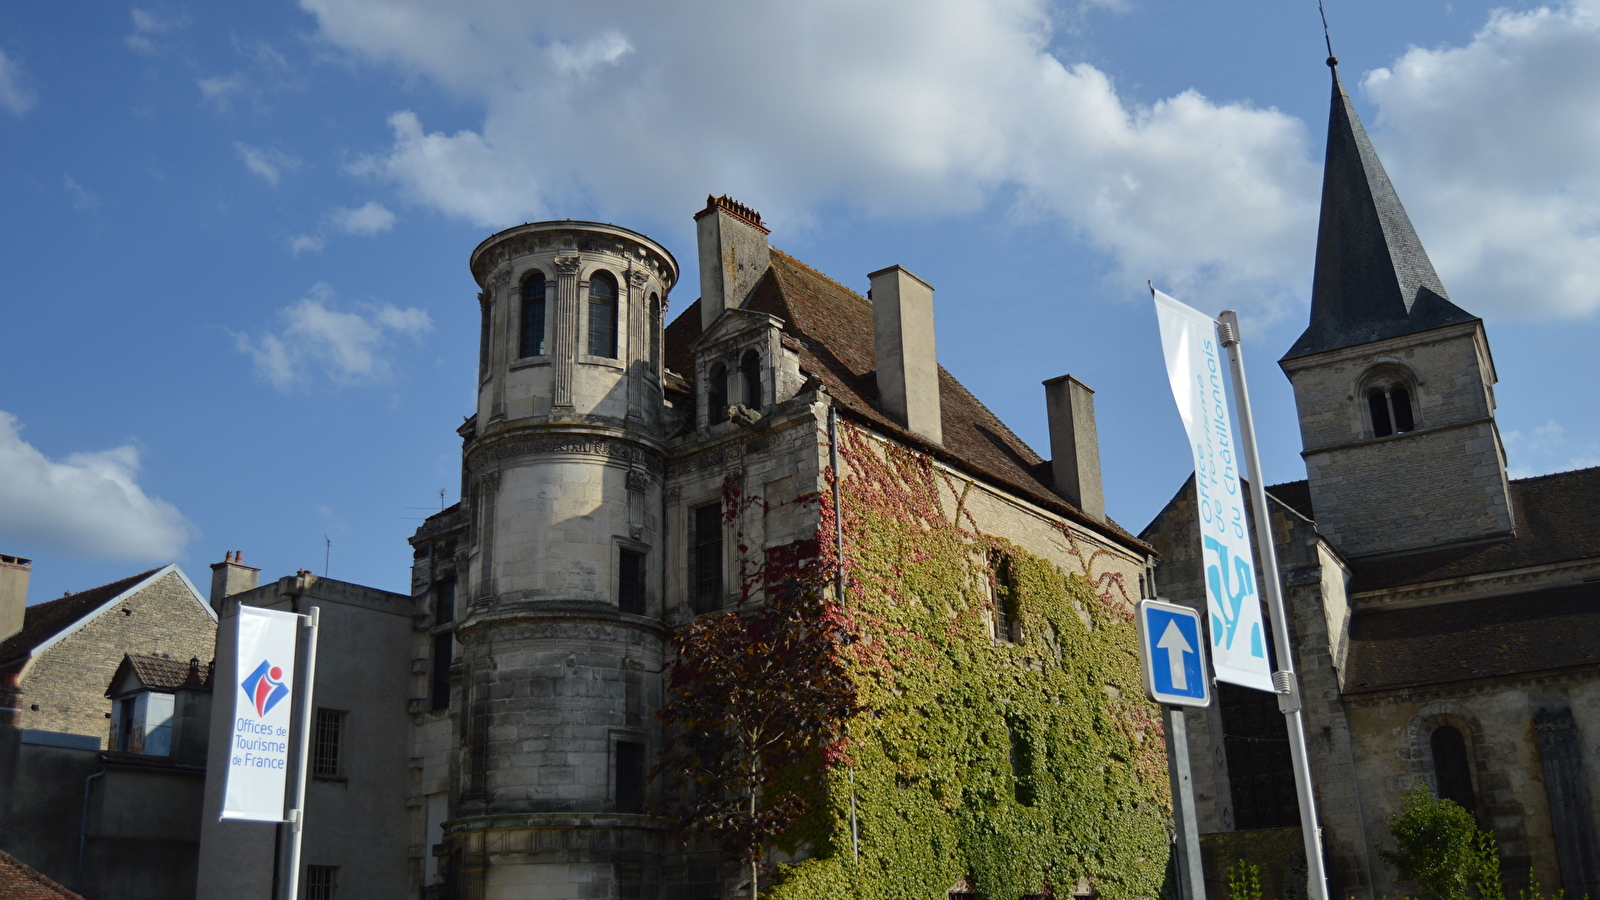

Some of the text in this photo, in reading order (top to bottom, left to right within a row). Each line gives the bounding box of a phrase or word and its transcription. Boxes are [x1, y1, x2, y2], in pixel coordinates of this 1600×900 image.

[1197, 374, 1225, 533] de Tourisme
[1202, 339, 1244, 539] du Châtillonnais
[1198, 444, 1212, 524] Office
[236, 735, 286, 753] Tourisme
[237, 718, 287, 737] Offices de
[232, 753, 285, 770] de France
